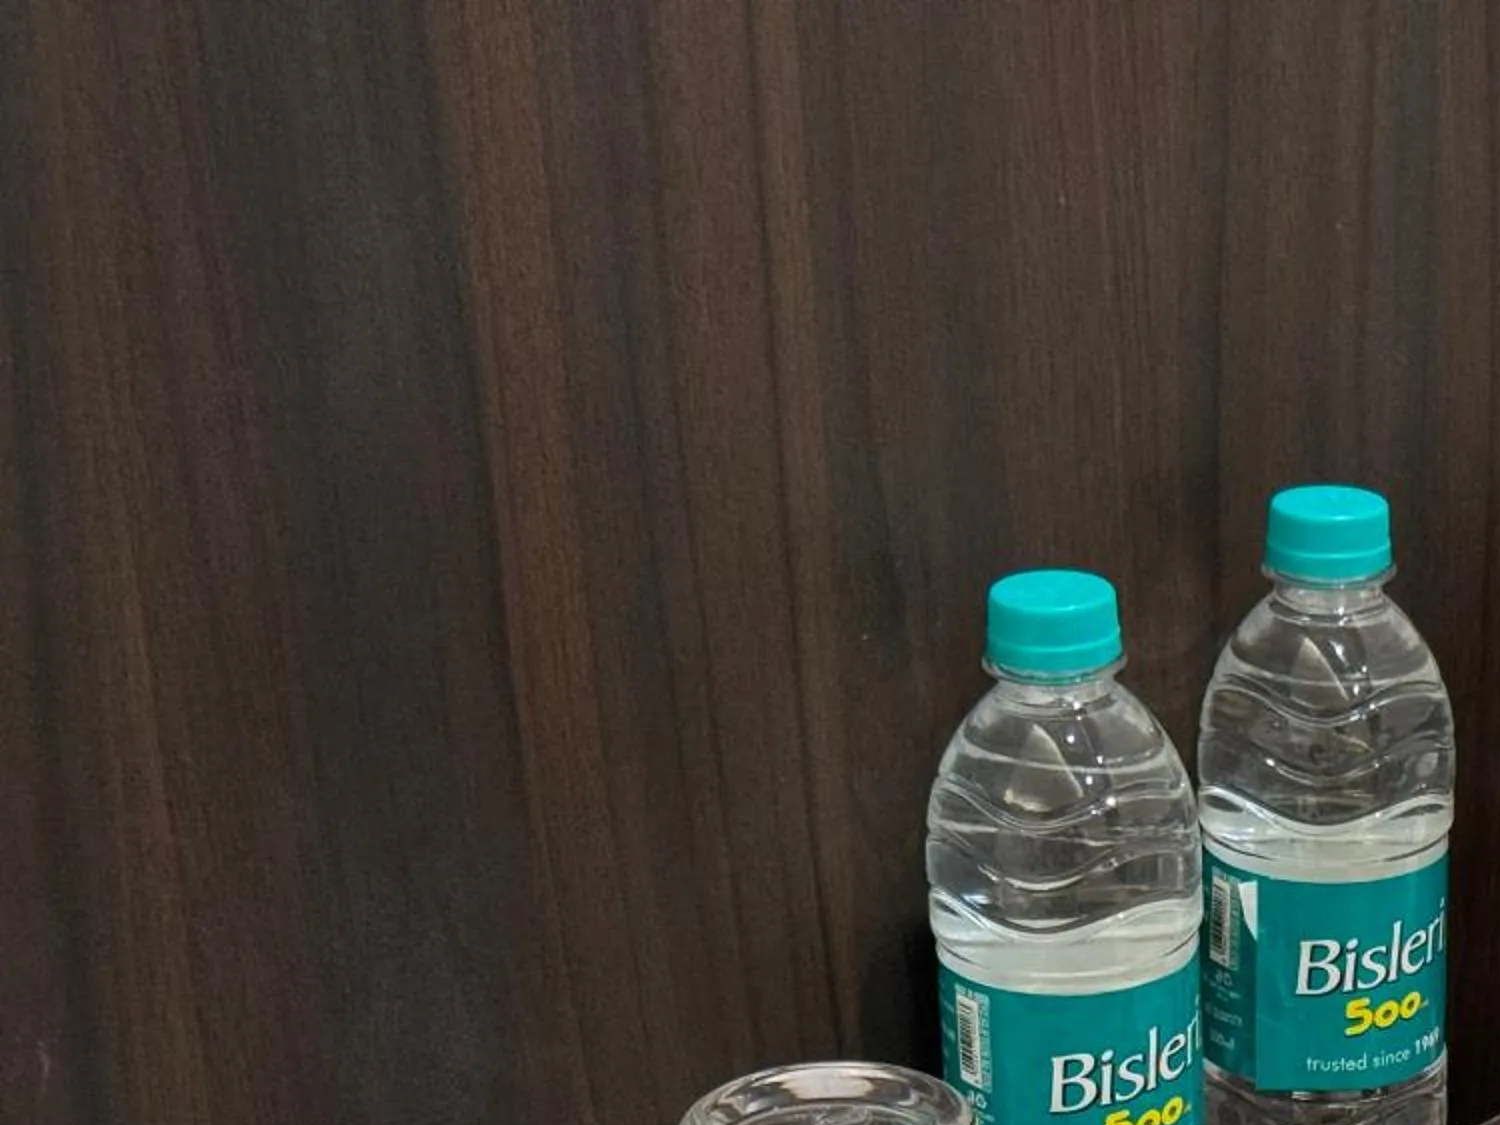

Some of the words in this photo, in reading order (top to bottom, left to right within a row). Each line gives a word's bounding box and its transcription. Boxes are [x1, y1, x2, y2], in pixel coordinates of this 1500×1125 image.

[1344, 991, 1422, 1036] 500
[1306, 1052, 1368, 1072] trusted
[1373, 1048, 1410, 1068] since
